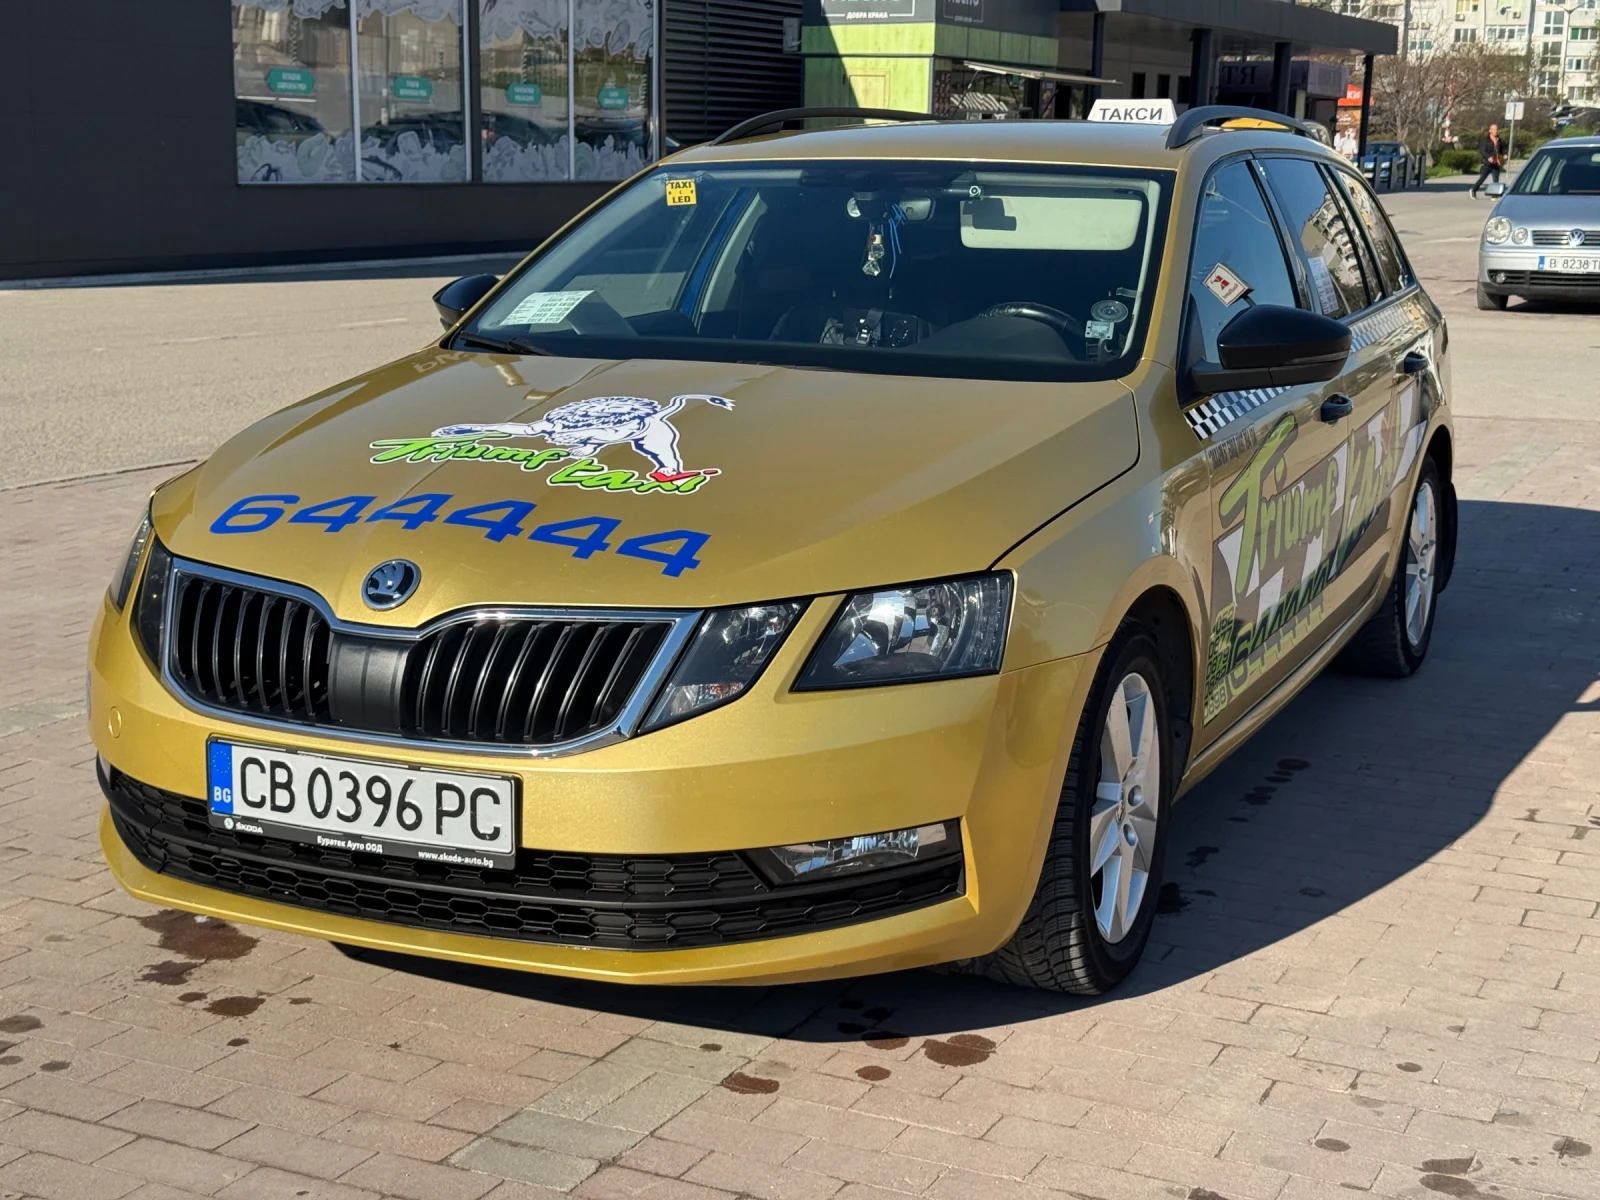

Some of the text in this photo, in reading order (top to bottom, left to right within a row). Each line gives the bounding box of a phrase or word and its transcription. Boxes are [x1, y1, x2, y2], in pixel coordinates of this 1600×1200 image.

[1099, 107, 1163, 121] ТАКСИ
[670, 181, 692, 189] TAXI
[1562, 258, 1589, 270] 8238
[371, 432, 722, 495] Triumf taxi
[1218, 411, 1339, 595] Triumf
[210, 493, 711, 578] 644444
[213, 786, 231, 803] BG
[240, 756, 501, 842] CB 0396 PC
[365, 842, 383, 854] ООД
[418, 850, 494, 869] www.skoda-auto.bg
